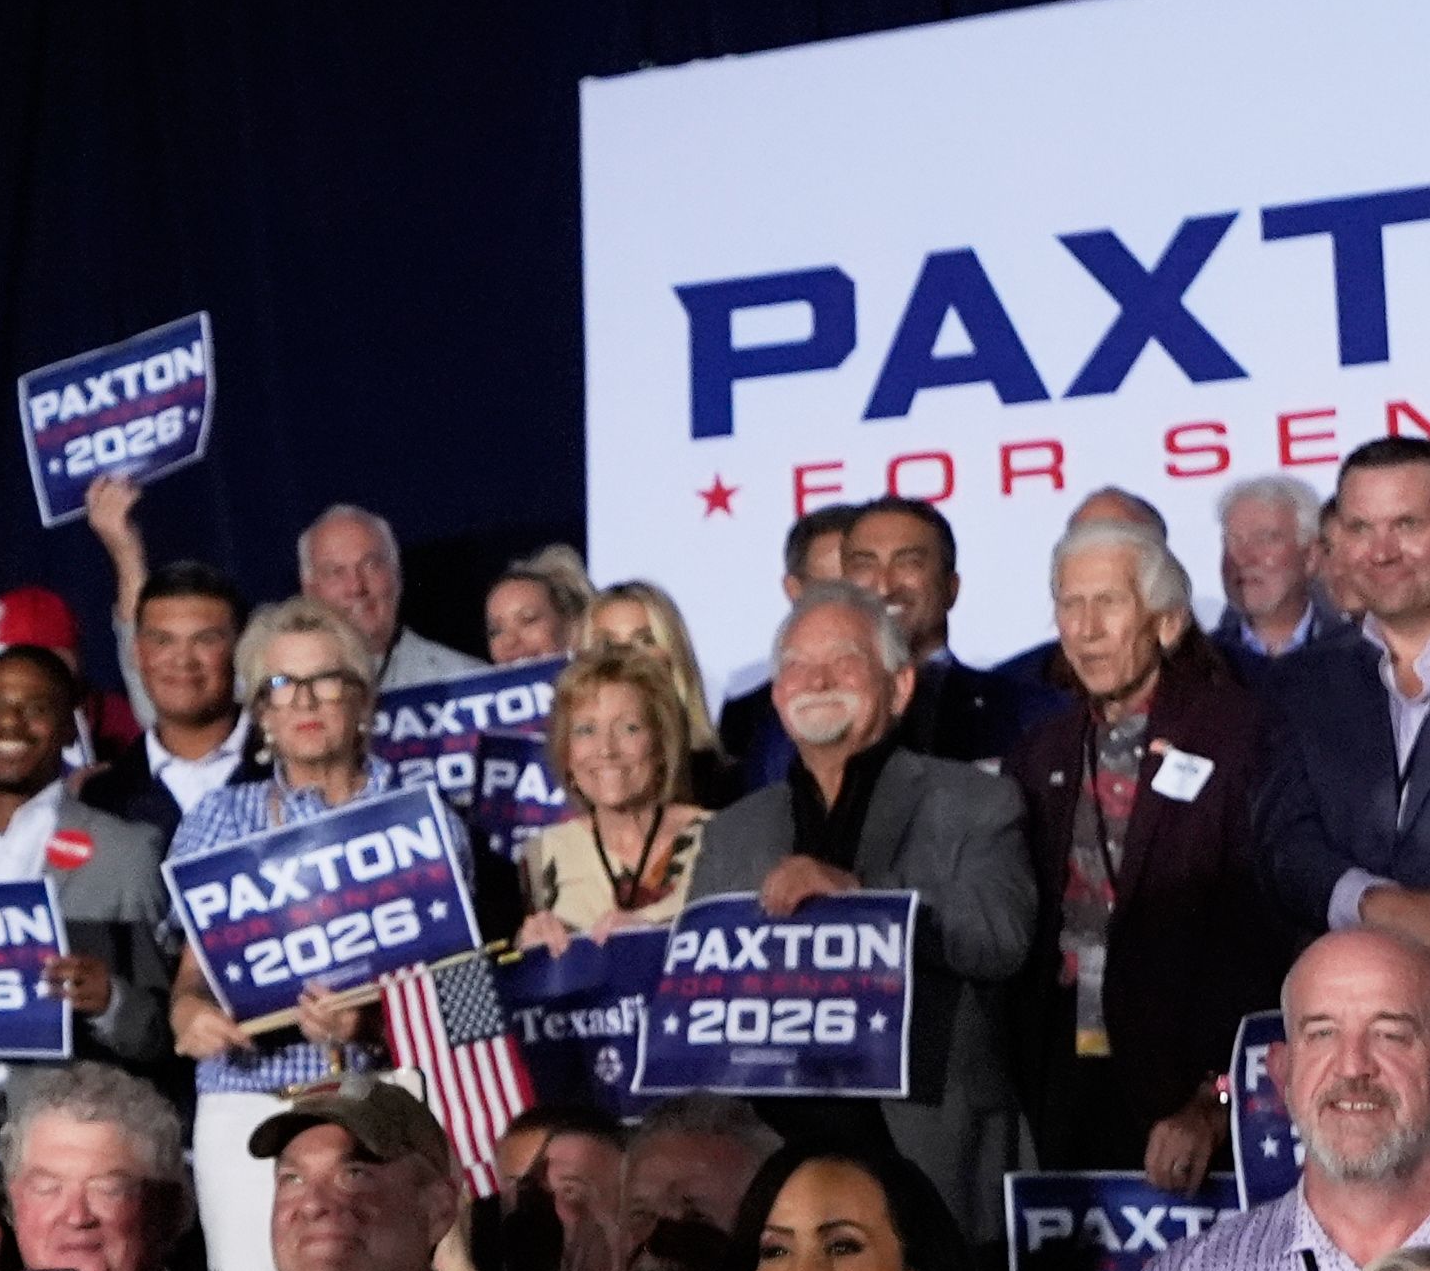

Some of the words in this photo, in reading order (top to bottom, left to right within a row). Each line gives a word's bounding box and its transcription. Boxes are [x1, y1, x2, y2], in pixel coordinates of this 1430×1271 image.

[29, 339, 205, 431] PAXTON
[64, 405, 185, 478] 2026
[793, 439, 1065, 517] FOR
[183, 815, 442, 930] PAXTON
[243, 897, 421, 987] 2026
[663, 923, 903, 975] PAXTON
[686, 998, 857, 1046] 2026
